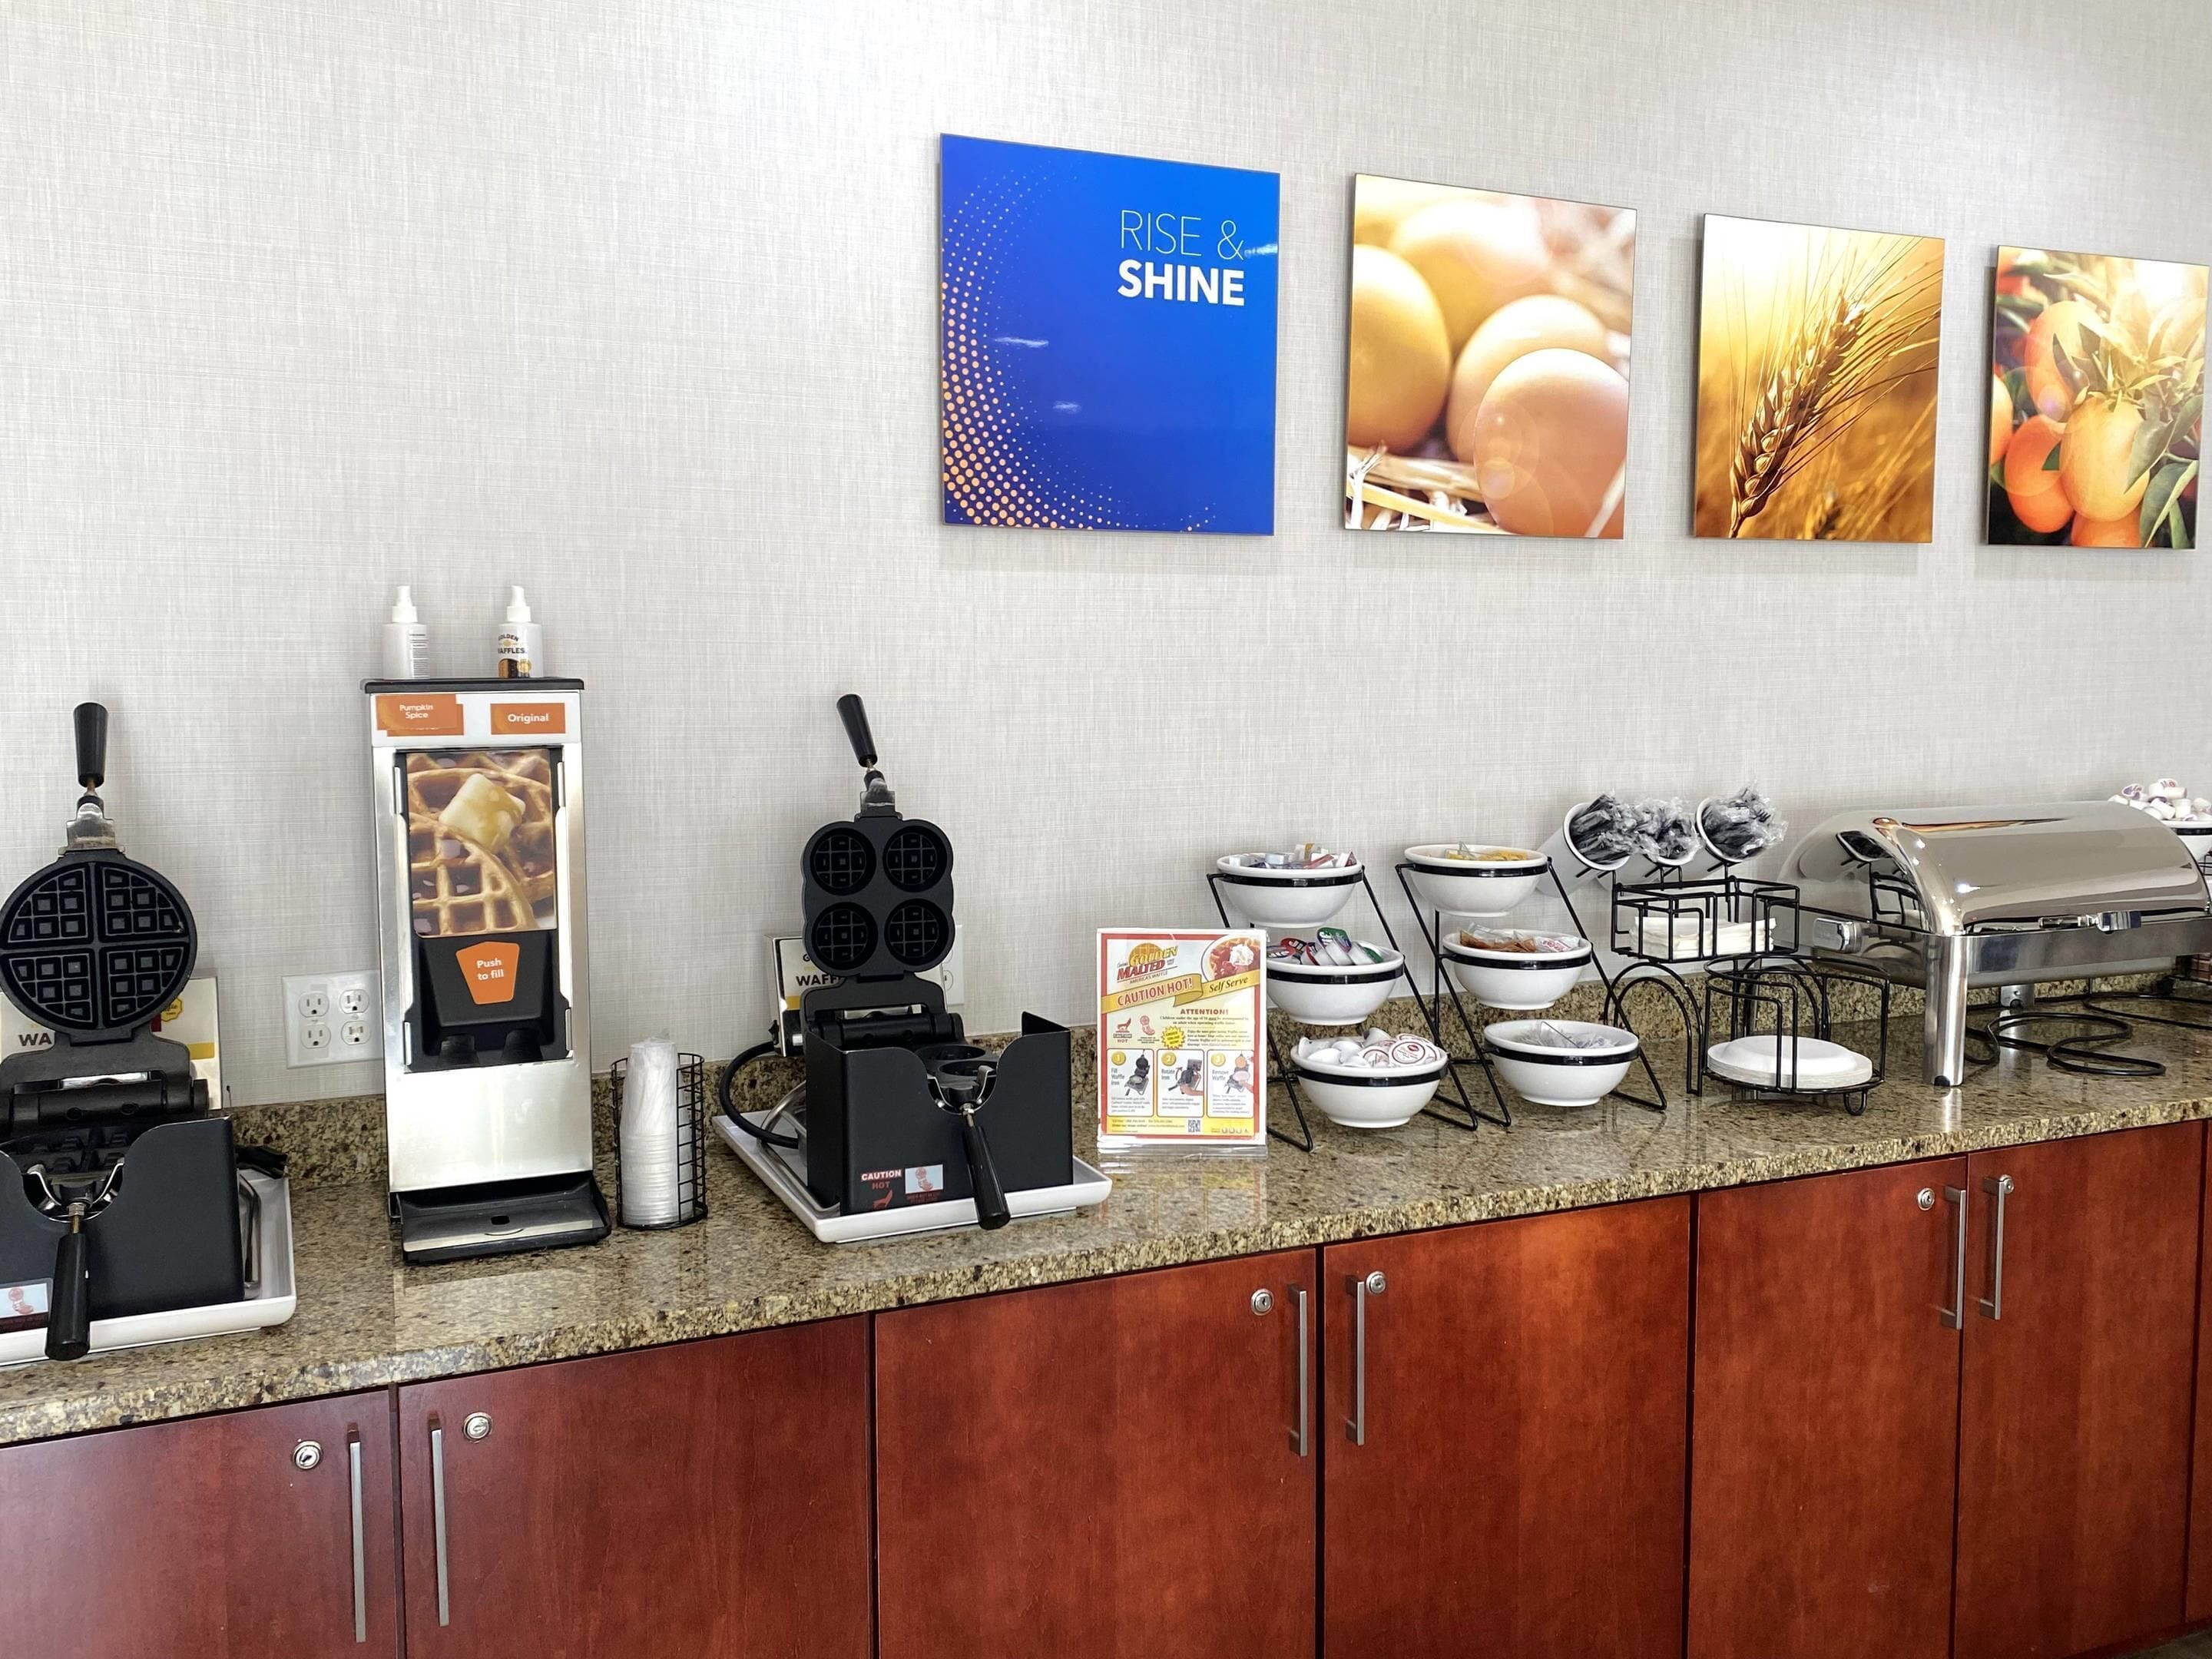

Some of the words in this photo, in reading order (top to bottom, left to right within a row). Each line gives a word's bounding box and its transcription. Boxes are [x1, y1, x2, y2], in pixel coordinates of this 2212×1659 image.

[1121, 210, 1202, 257] RISE
[1217, 220, 1244, 261] &
[1118, 259, 1245, 306] SHINE
[399, 704, 434, 713] Pumpkin
[405, 711, 429, 720] Spice
[507, 714, 550, 724] Original
[1130, 945, 1179, 966] GOLDEN
[476, 958, 502, 969] Push
[490, 969, 505, 979] fill
[1117, 959, 1166, 981] MALTED
[1209, 982, 1225, 993] Self
[1226, 976, 1248, 988] Serve
[1118, 985, 1167, 1006] CAUTION
[1167, 977, 1193, 996] HOT!
[861, 1169, 902, 1181] CAUTION
[872, 1181, 891, 1190] HOT
